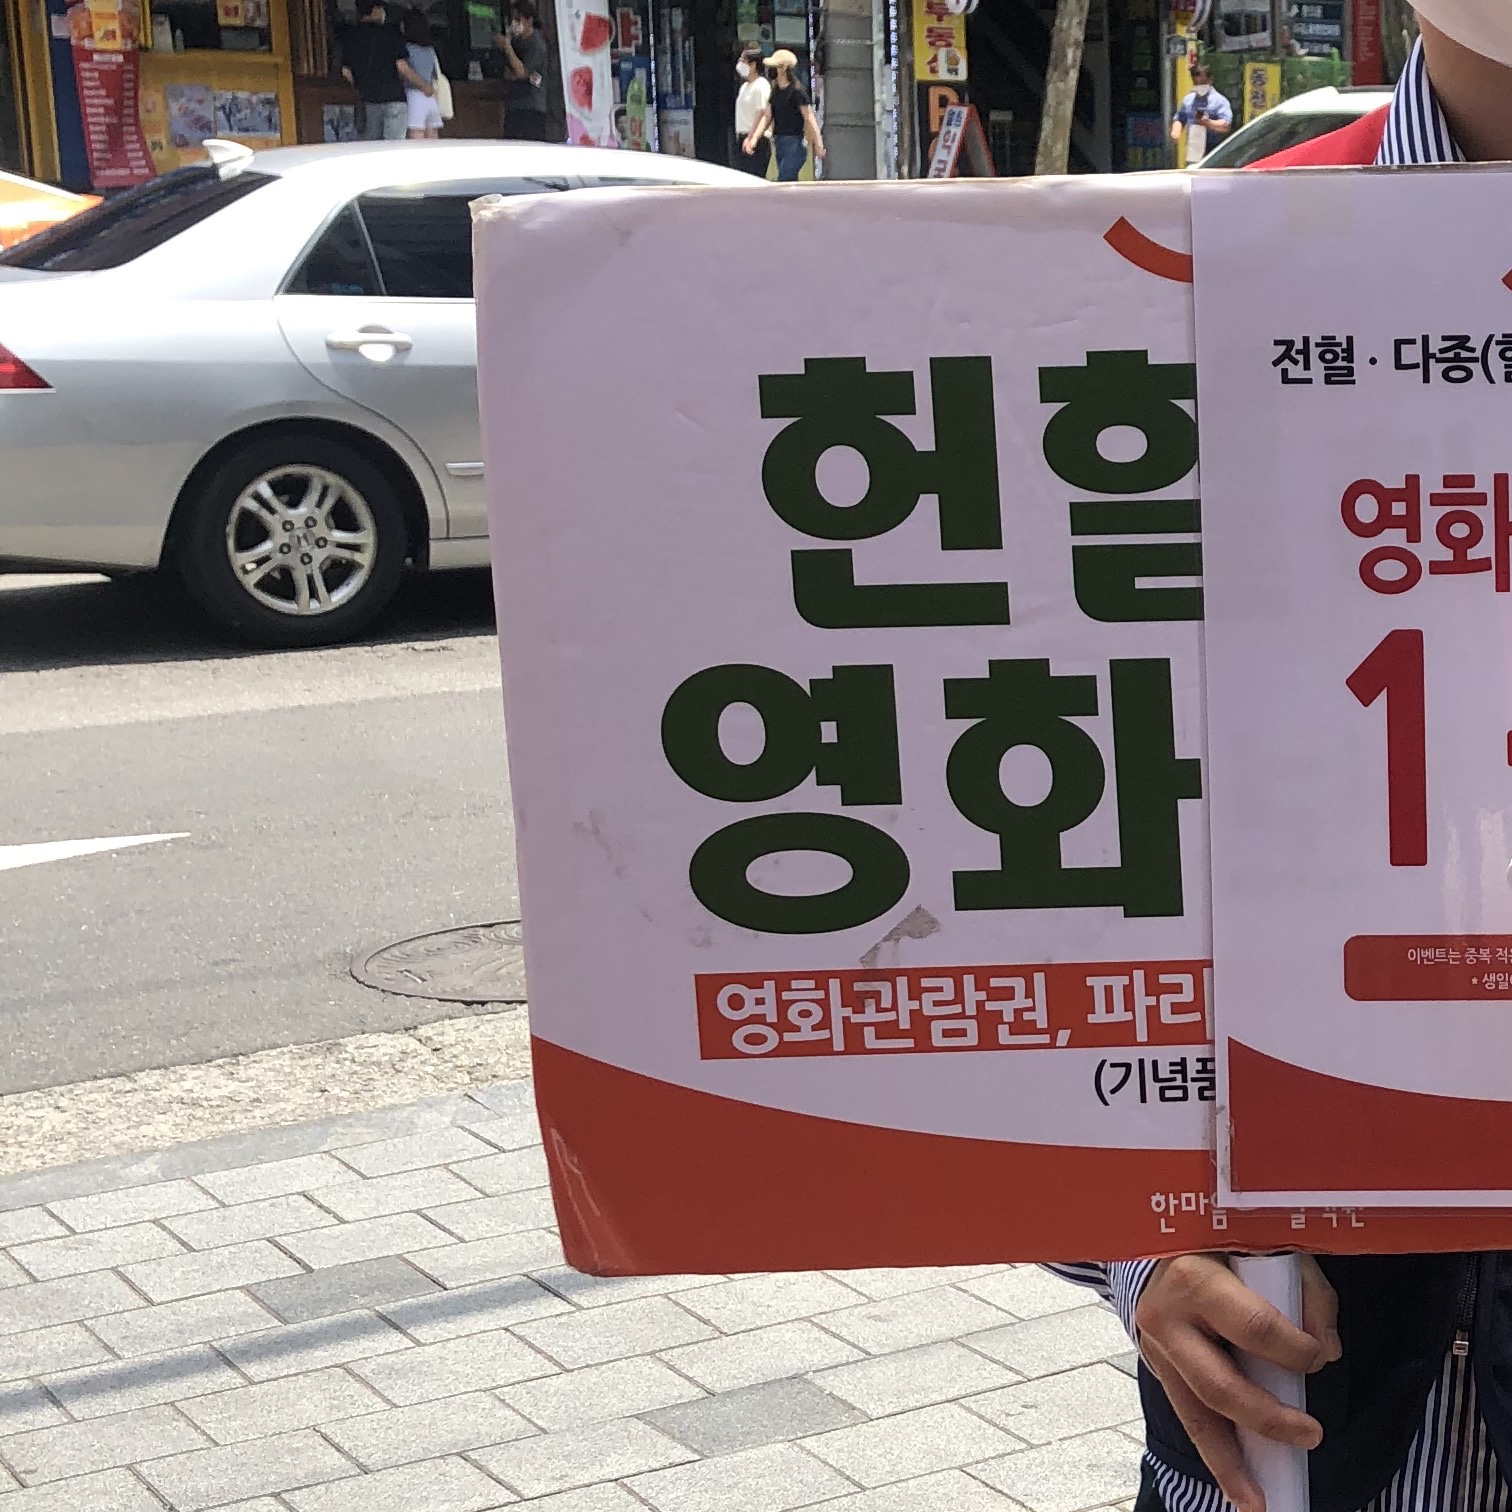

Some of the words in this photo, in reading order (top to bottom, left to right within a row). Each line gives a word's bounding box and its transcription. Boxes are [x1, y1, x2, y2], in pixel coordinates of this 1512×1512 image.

[661, 658, 1203, 934] 영화
[1408, 947, 1461, 965] 이벤트는
[1465, 947, 1492, 965] 중복
[716, 972, 1071, 1054] 영화관람권,
